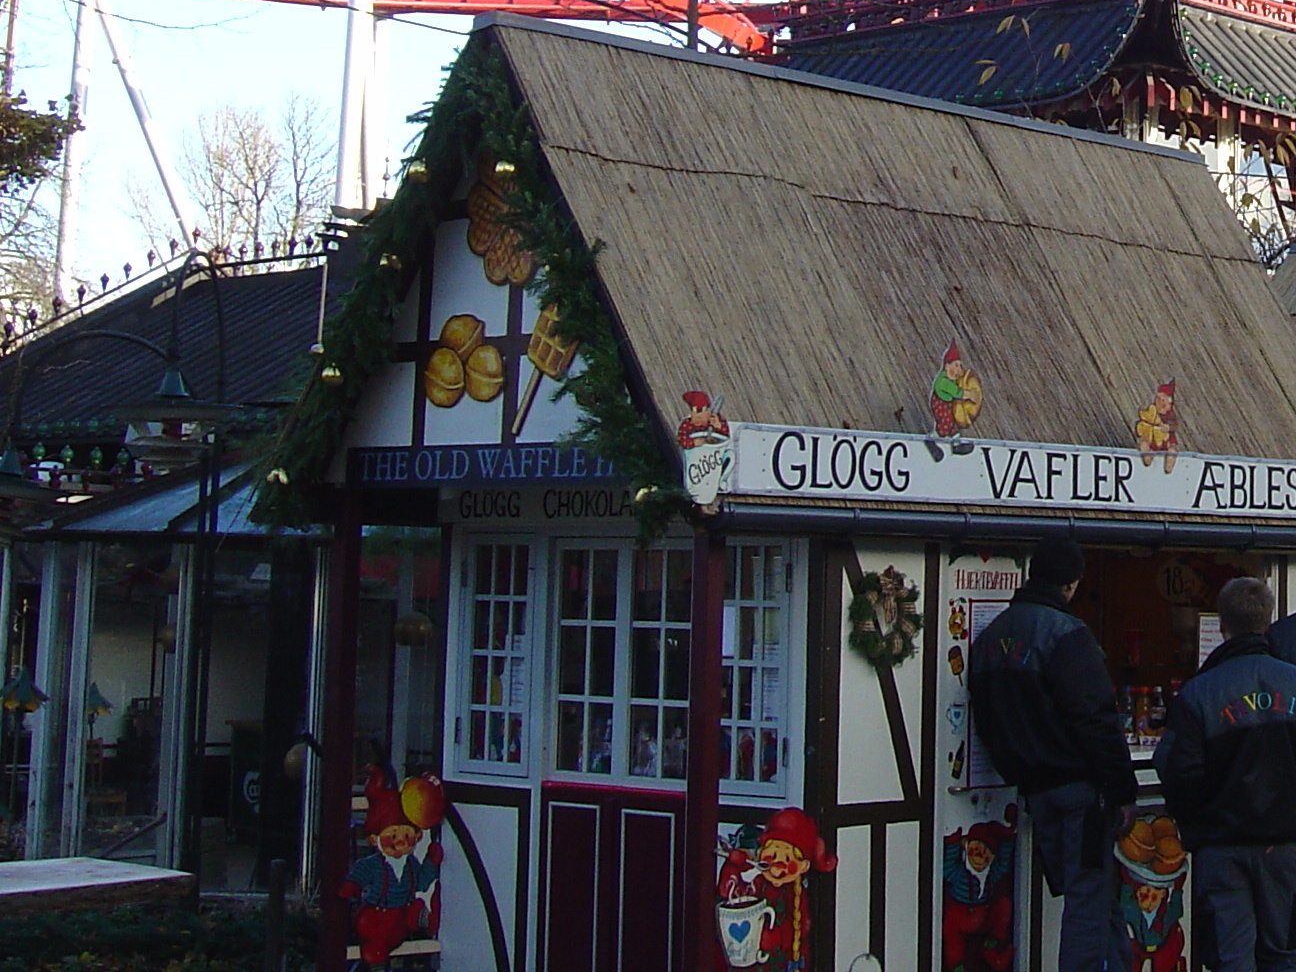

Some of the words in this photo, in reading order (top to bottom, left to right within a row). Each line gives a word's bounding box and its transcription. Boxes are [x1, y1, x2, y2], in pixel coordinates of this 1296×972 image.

[361, 451, 408, 480] THE
[415, 449, 469, 479] OLD
[477, 446, 587, 478] WAFFLE
[688, 450, 723, 485] GLÖGG
[771, 431, 910, 492] GLÖGG
[981, 446, 1135, 503] VAFLER
[1219, 692, 1296, 724] TIVOLI
